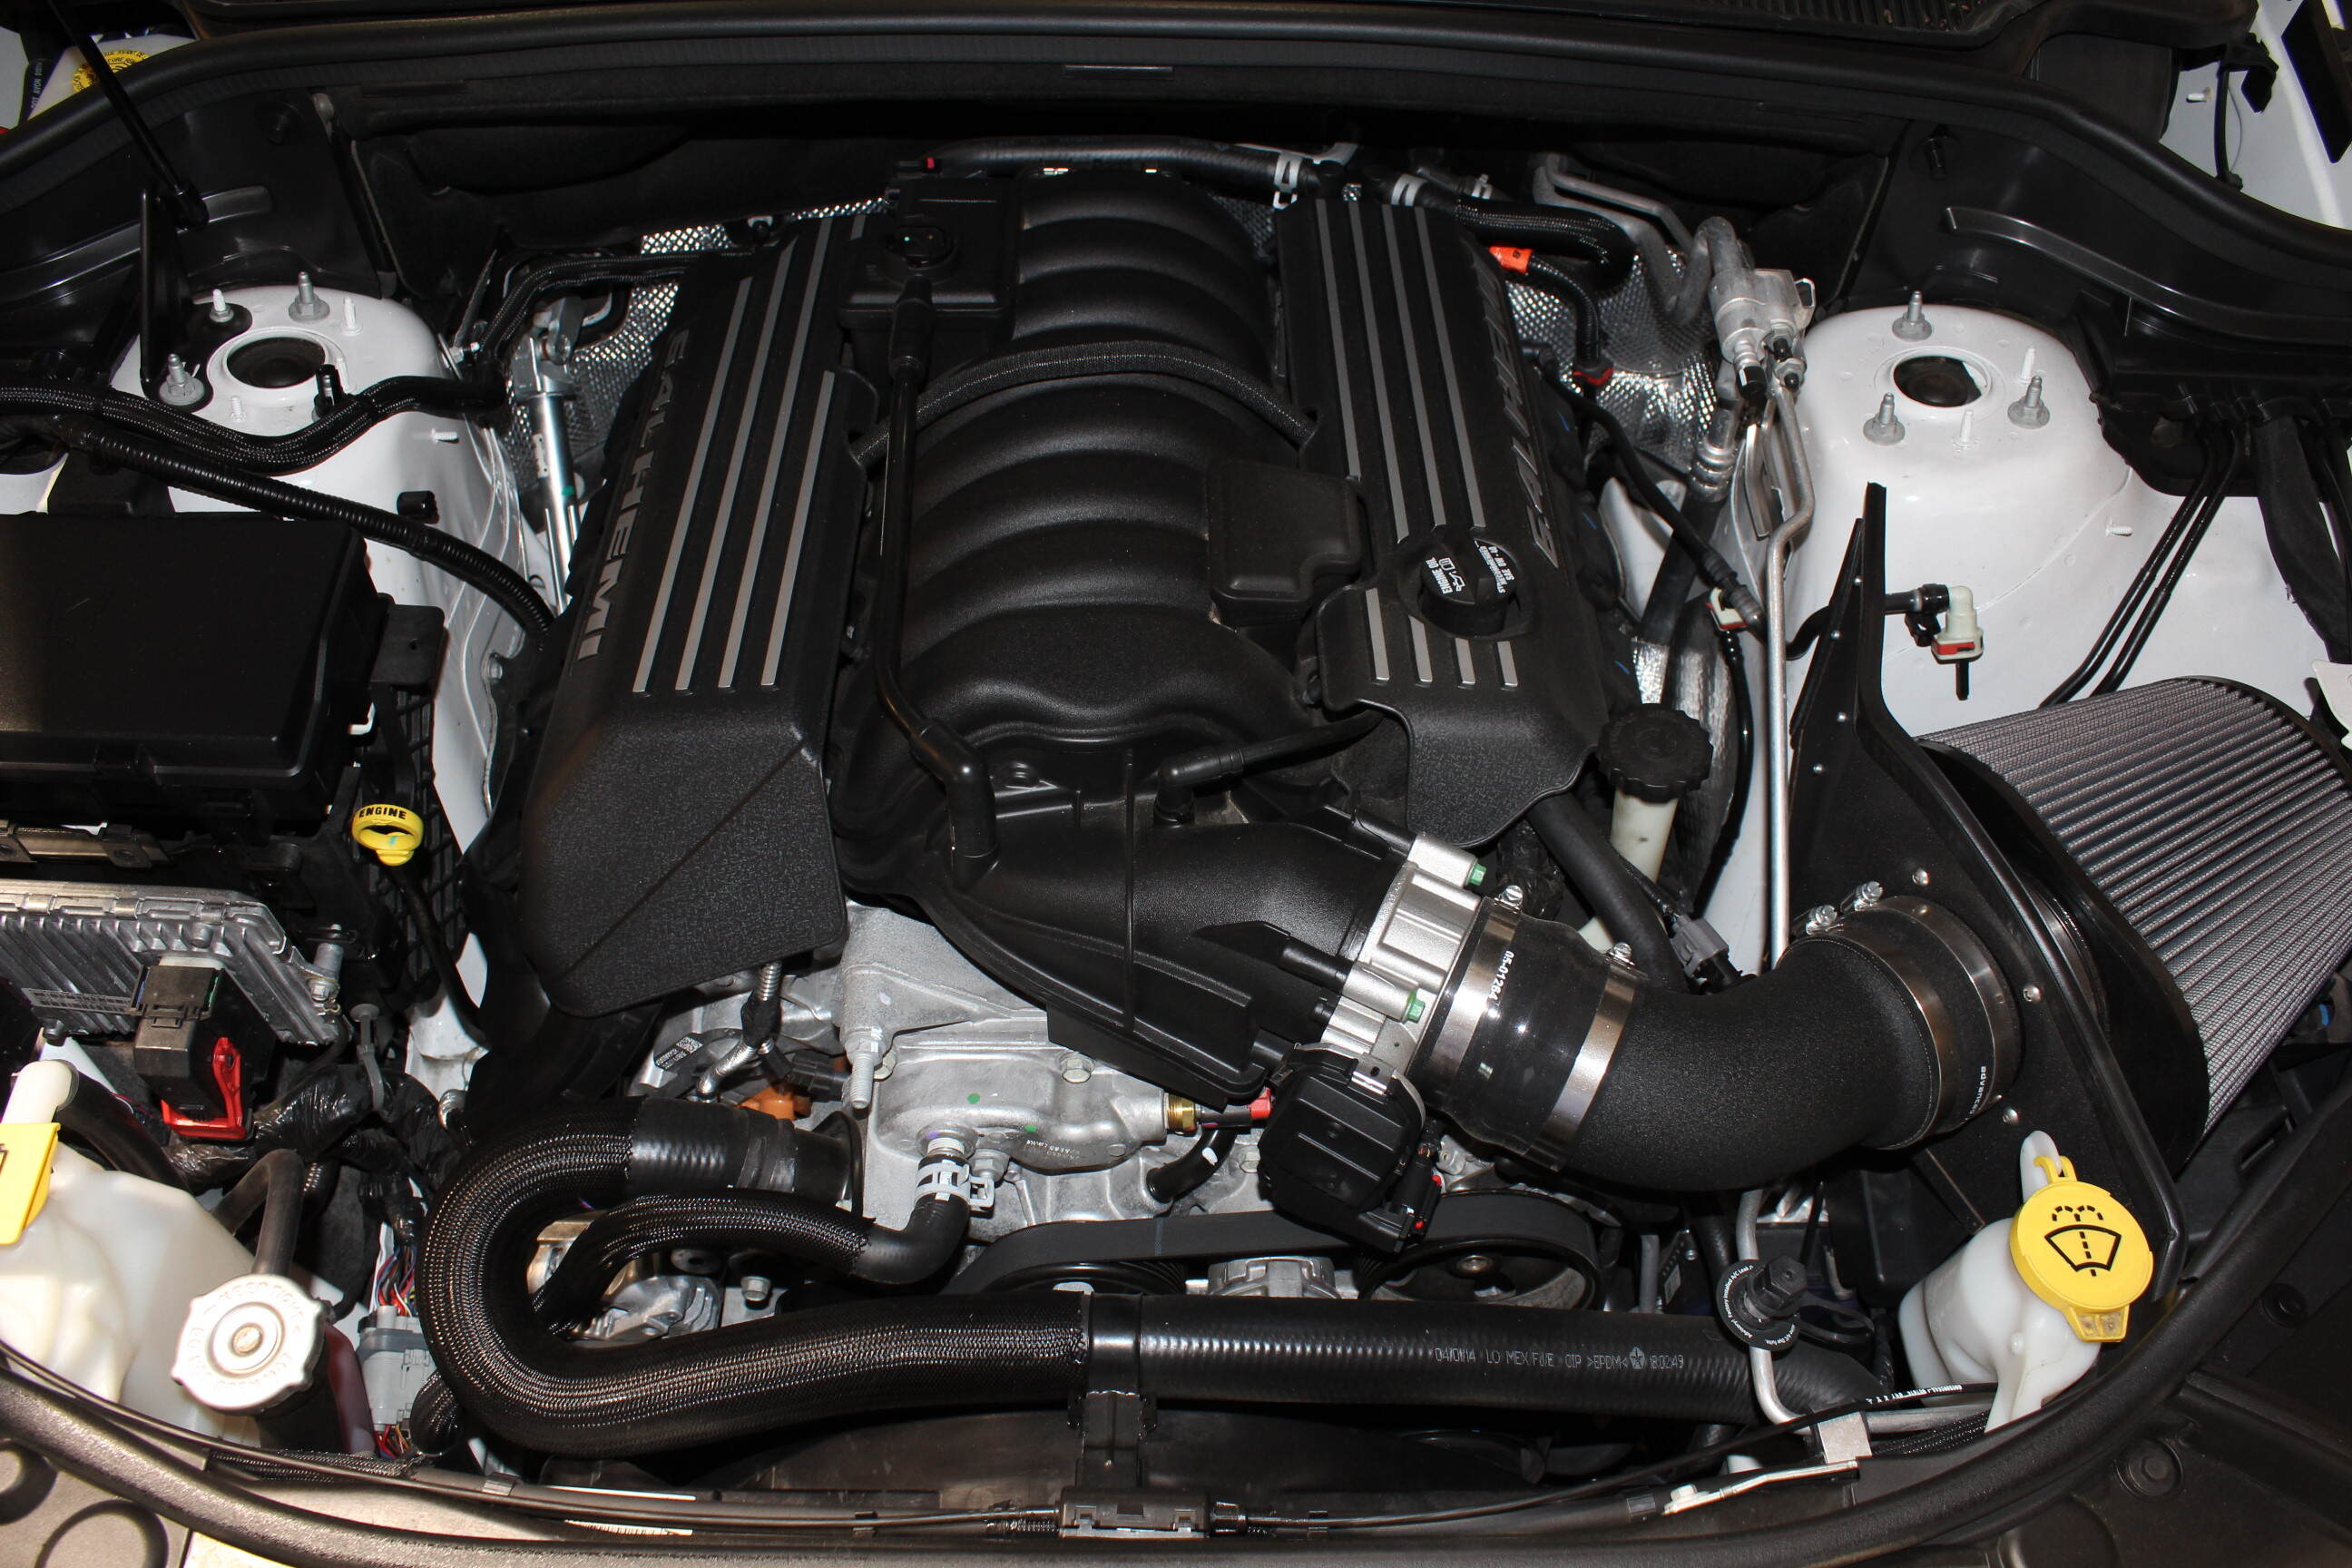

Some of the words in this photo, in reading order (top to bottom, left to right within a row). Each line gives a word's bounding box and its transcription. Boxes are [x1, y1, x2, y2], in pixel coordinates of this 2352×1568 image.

[577, 450, 655, 662] HEMI
[1426, 556, 1439, 569] OIL
[1431, 567, 1454, 594] ENGINE
[1502, 568, 1515, 581] SAE
[358, 807, 407, 820] ENGINE
[1488, 950, 1515, 1001] 05-01264
[1506, 1349, 1530, 1366] MEX
